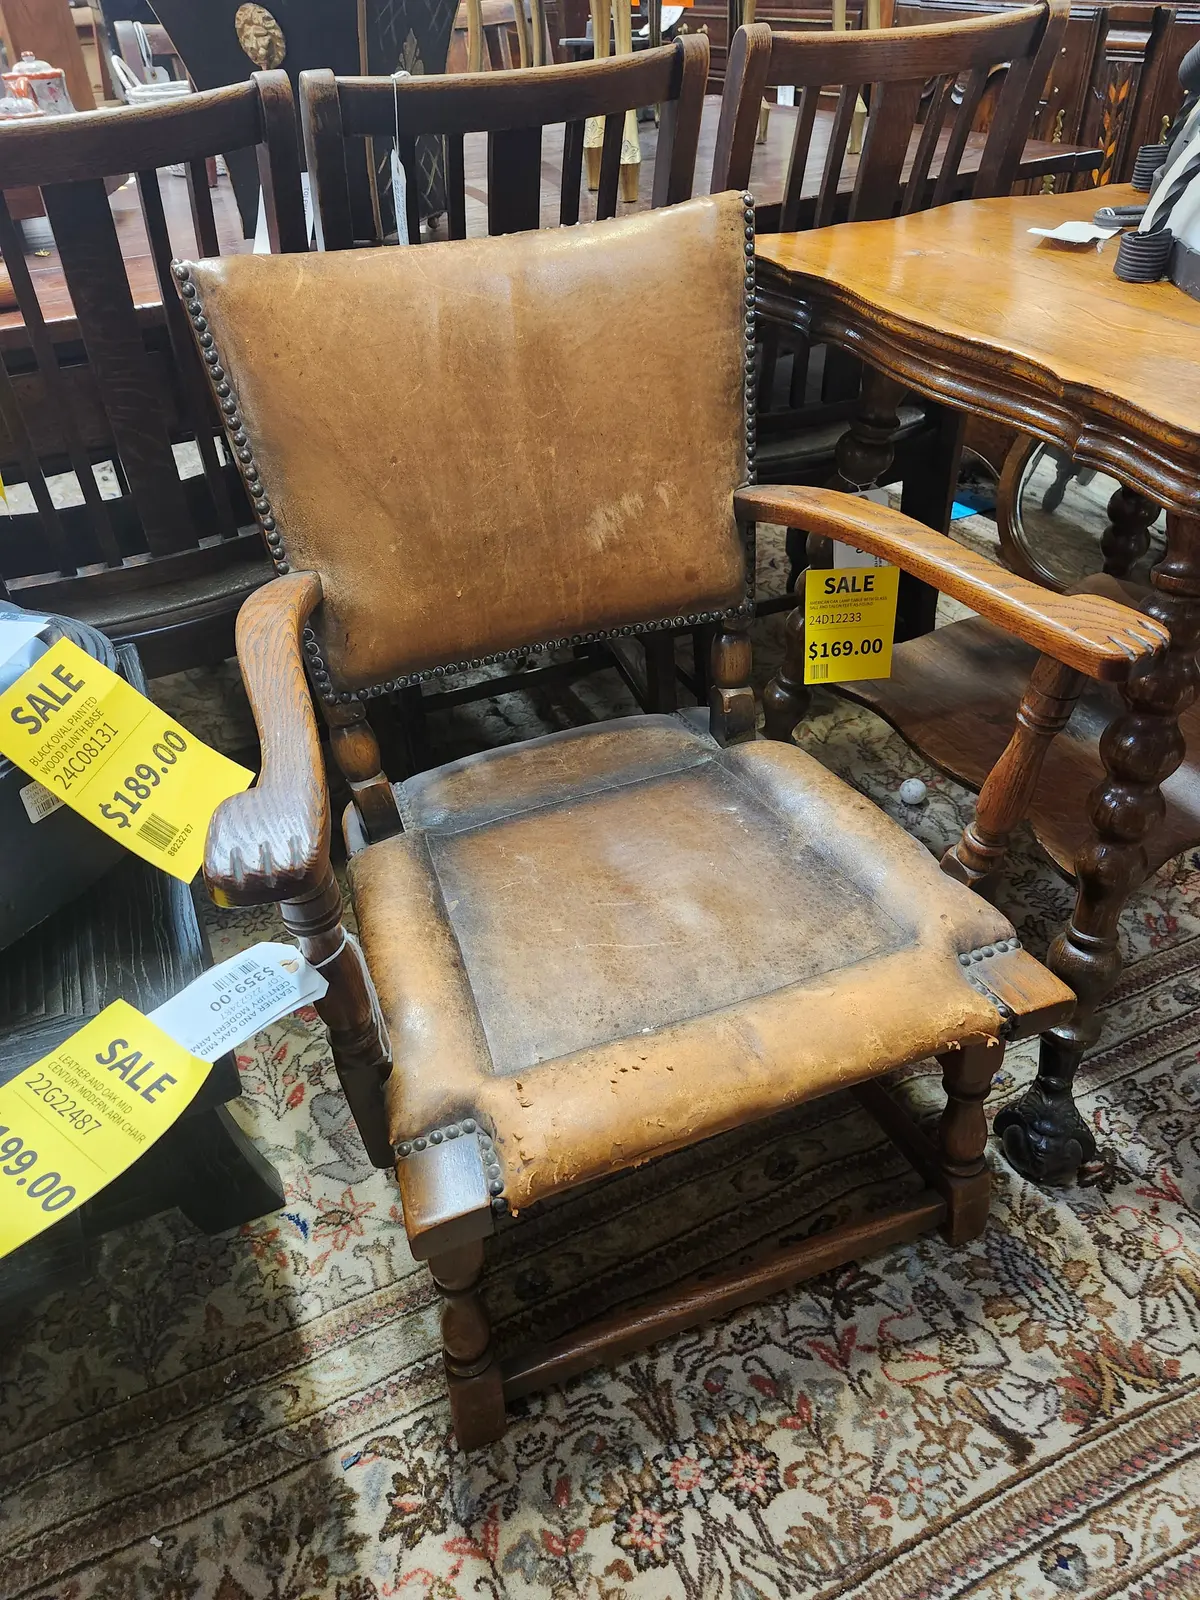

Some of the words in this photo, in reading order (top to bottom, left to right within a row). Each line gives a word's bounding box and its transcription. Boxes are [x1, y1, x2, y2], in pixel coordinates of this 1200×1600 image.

[824, 575, 875, 594] SALE
[809, 612, 862, 626] 24D12233
[808, 638, 883, 661] $169.00
[11, 664, 85, 735] SALE
[29, 741, 55, 766] BLACK
[51, 726, 72, 744] OVAL
[67, 697, 97, 726] PAINTED
[40, 751, 64, 774] WOOD
[61, 725, 88, 753] PLINTH
[84, 708, 104, 728] BASE
[54, 722, 118, 790] 24C08131
[99, 731, 187, 828] $189.00
[209, 966, 275, 1012] $359.00
[221, 987, 263, 1020] 22G22487
[252, 981, 290, 1007] CENTURY
[258, 986, 296, 1012] LEATHER
[213, 1007, 250, 1036] MODERN
[219, 1027, 238, 1042] OAK
[239, 1011, 256, 1026] AND
[190, 1036, 210, 1052] ARM
[201, 1041, 218, 1055] MID
[58, 1054, 90, 1080] LEATHER
[87, 1077, 104, 1091] AND
[102, 1088, 119, 1103] OAK
[116, 1100, 132, 1113] MID
[95, 1039, 177, 1103] SALE
[25, 1073, 102, 1135] 22G22487
[48, 1062, 81, 1088] CENTURY
[77, 1086, 109, 1115] MODERN
[105, 1110, 124, 1125] ARM
[122, 1123, 146, 1144] CHAIR
